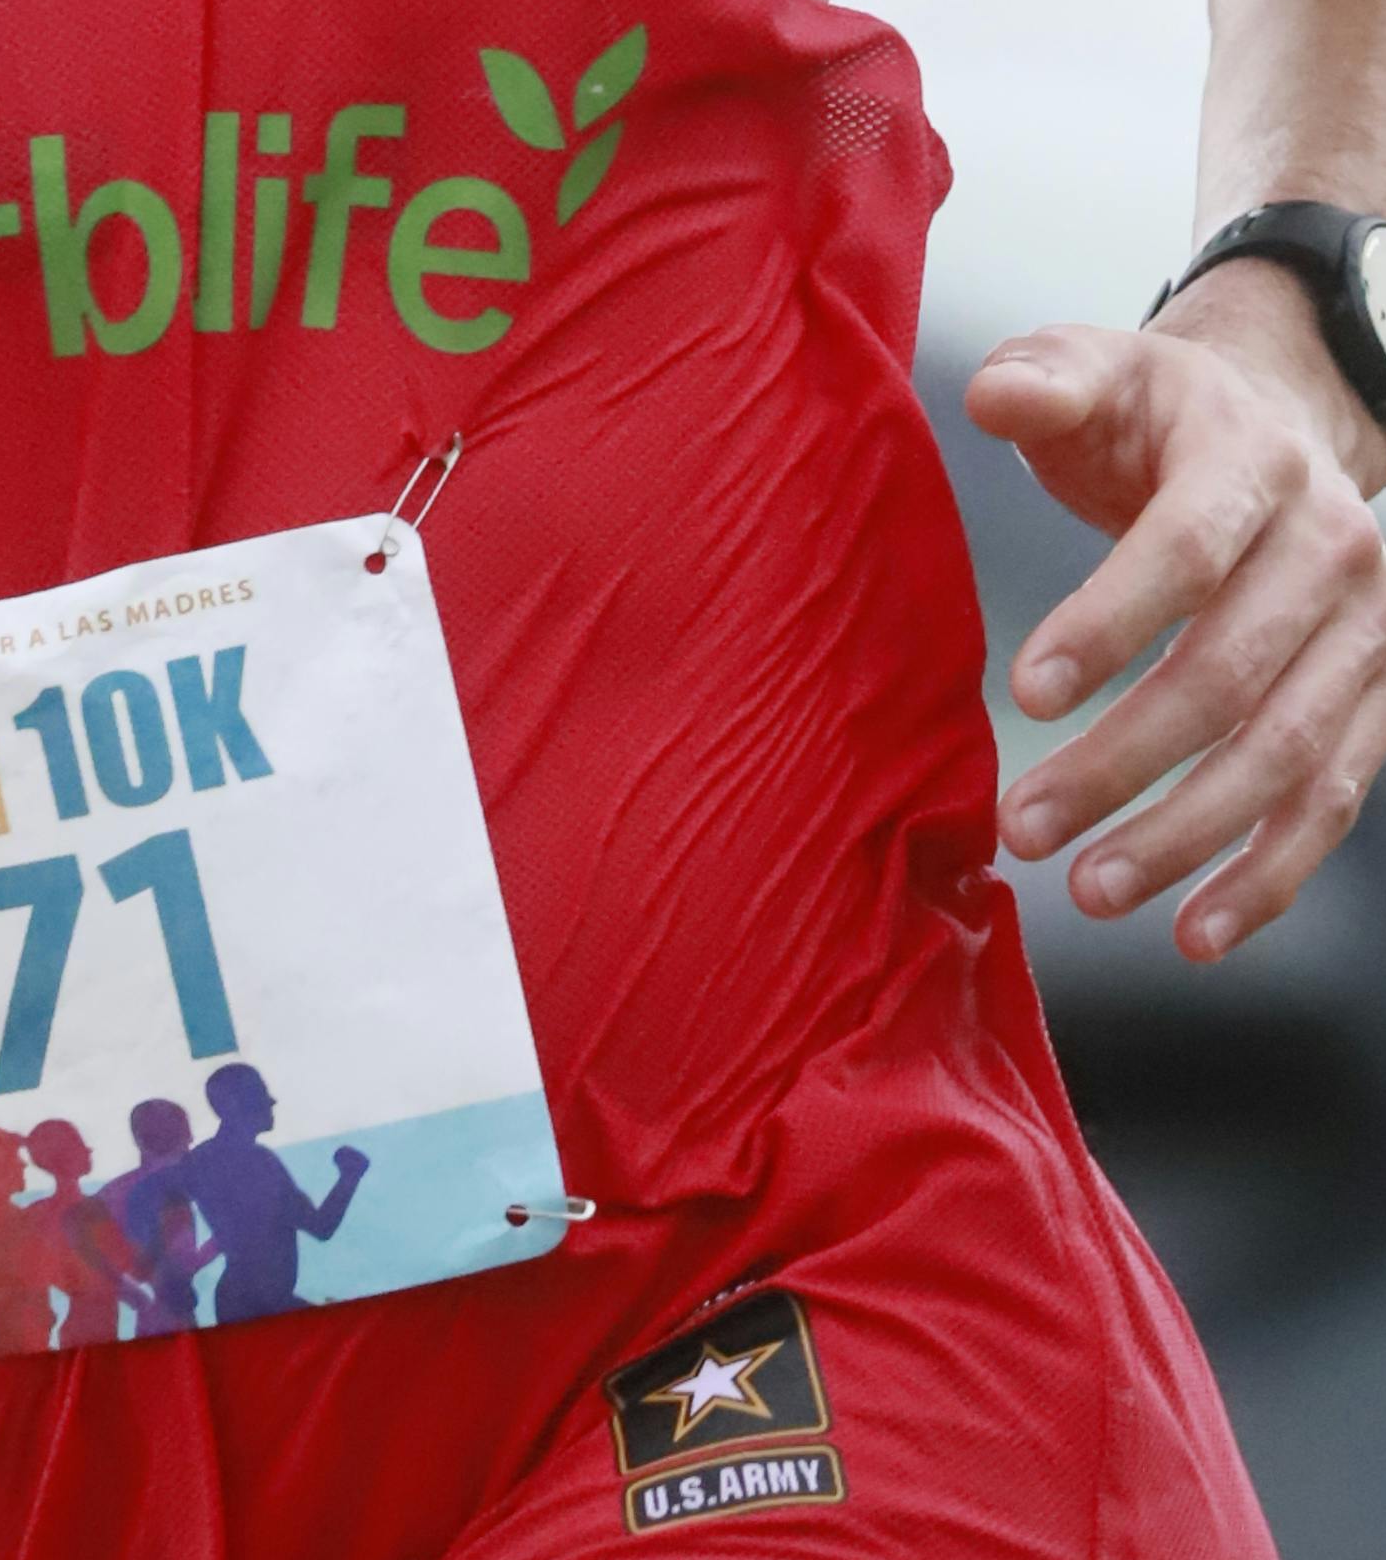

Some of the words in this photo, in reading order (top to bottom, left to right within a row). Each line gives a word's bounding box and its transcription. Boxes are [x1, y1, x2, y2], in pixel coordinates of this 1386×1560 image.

[28, 628, 46, 649] A
[60, 610, 114, 641] LAS
[125, 579, 254, 626] MADRES
[13, 644, 275, 821] 10K
